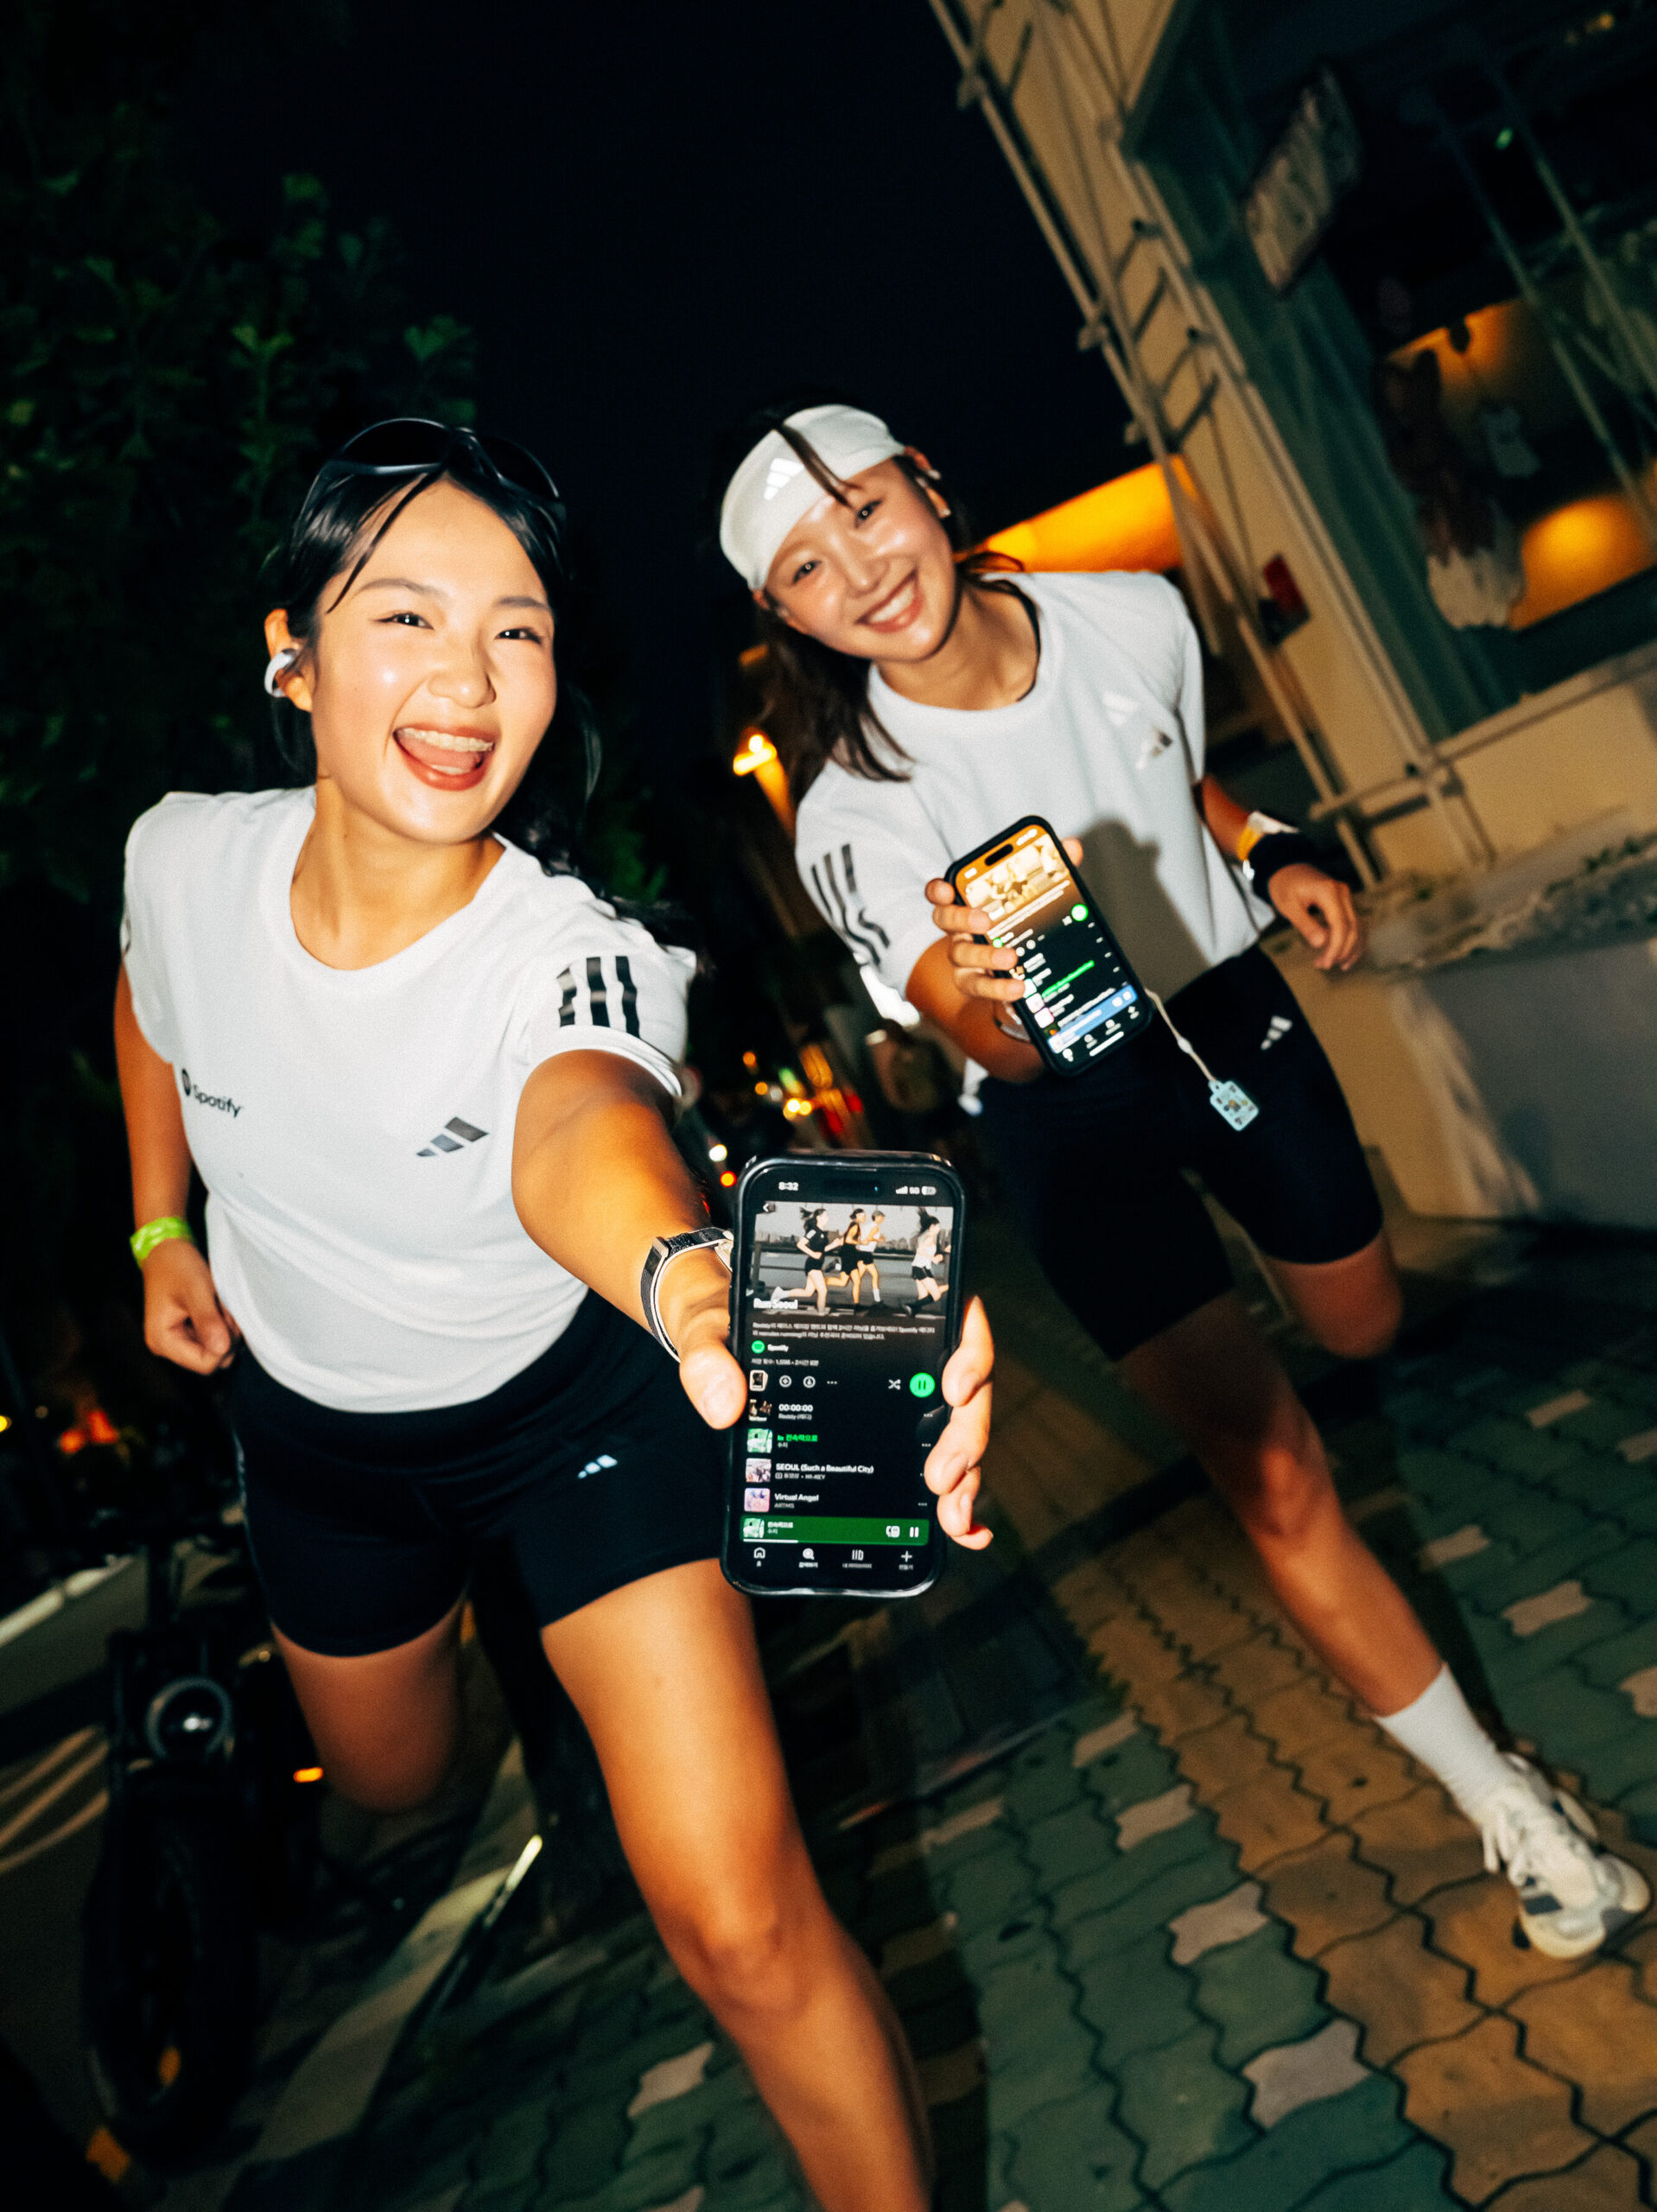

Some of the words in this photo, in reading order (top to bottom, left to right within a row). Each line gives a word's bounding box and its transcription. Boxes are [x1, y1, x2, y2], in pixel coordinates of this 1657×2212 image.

[194, 1084, 242, 1118] Spotify
[772, 1299, 798, 1310] Seoul
[778, 1403, 814, 1412] 00:00:00
[776, 1463, 800, 1471] SEOUL
[801, 1464, 821, 1472] (Such
[857, 1465, 874, 1474] City)
[798, 1493, 820, 1503] Angel
